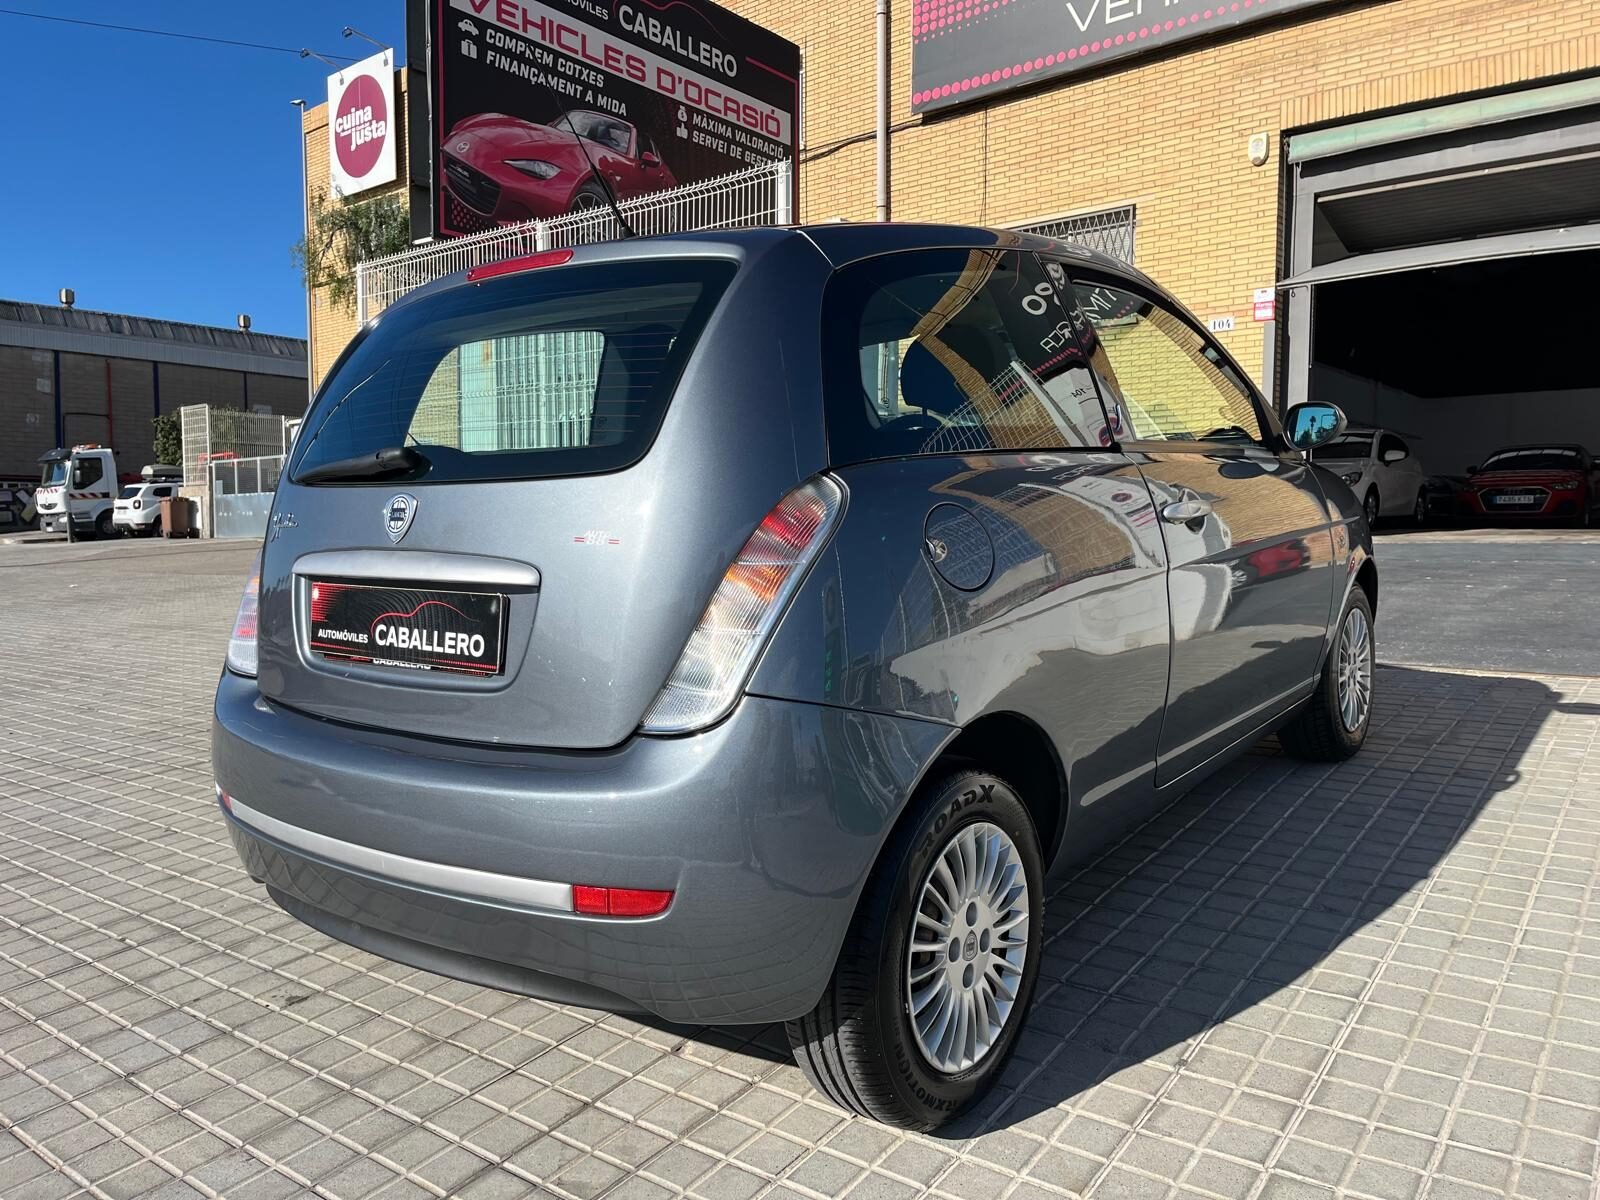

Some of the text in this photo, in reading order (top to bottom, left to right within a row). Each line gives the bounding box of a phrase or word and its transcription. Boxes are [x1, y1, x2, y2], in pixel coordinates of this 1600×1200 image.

[486, 29, 604, 87] COMPREM COTXES
[619, 5, 738, 77] CABALLERO
[469, 0, 781, 138] VEHICLES D'OCASIÓ
[486, 50, 627, 117] FINANÇAMENT A MIDA
[335, 105, 373, 133] cuina
[350, 120, 386, 151] justa
[692, 113, 784, 159] MÀXIMA VALORACIÓ
[692, 130, 727, 154] SERVEI
[729, 144, 743, 160] DE
[1212, 319, 1231, 331] 104
[317, 623, 485, 658] AUTOMÓVILES CABALLERO
[918, 784, 995, 858] ROADX
